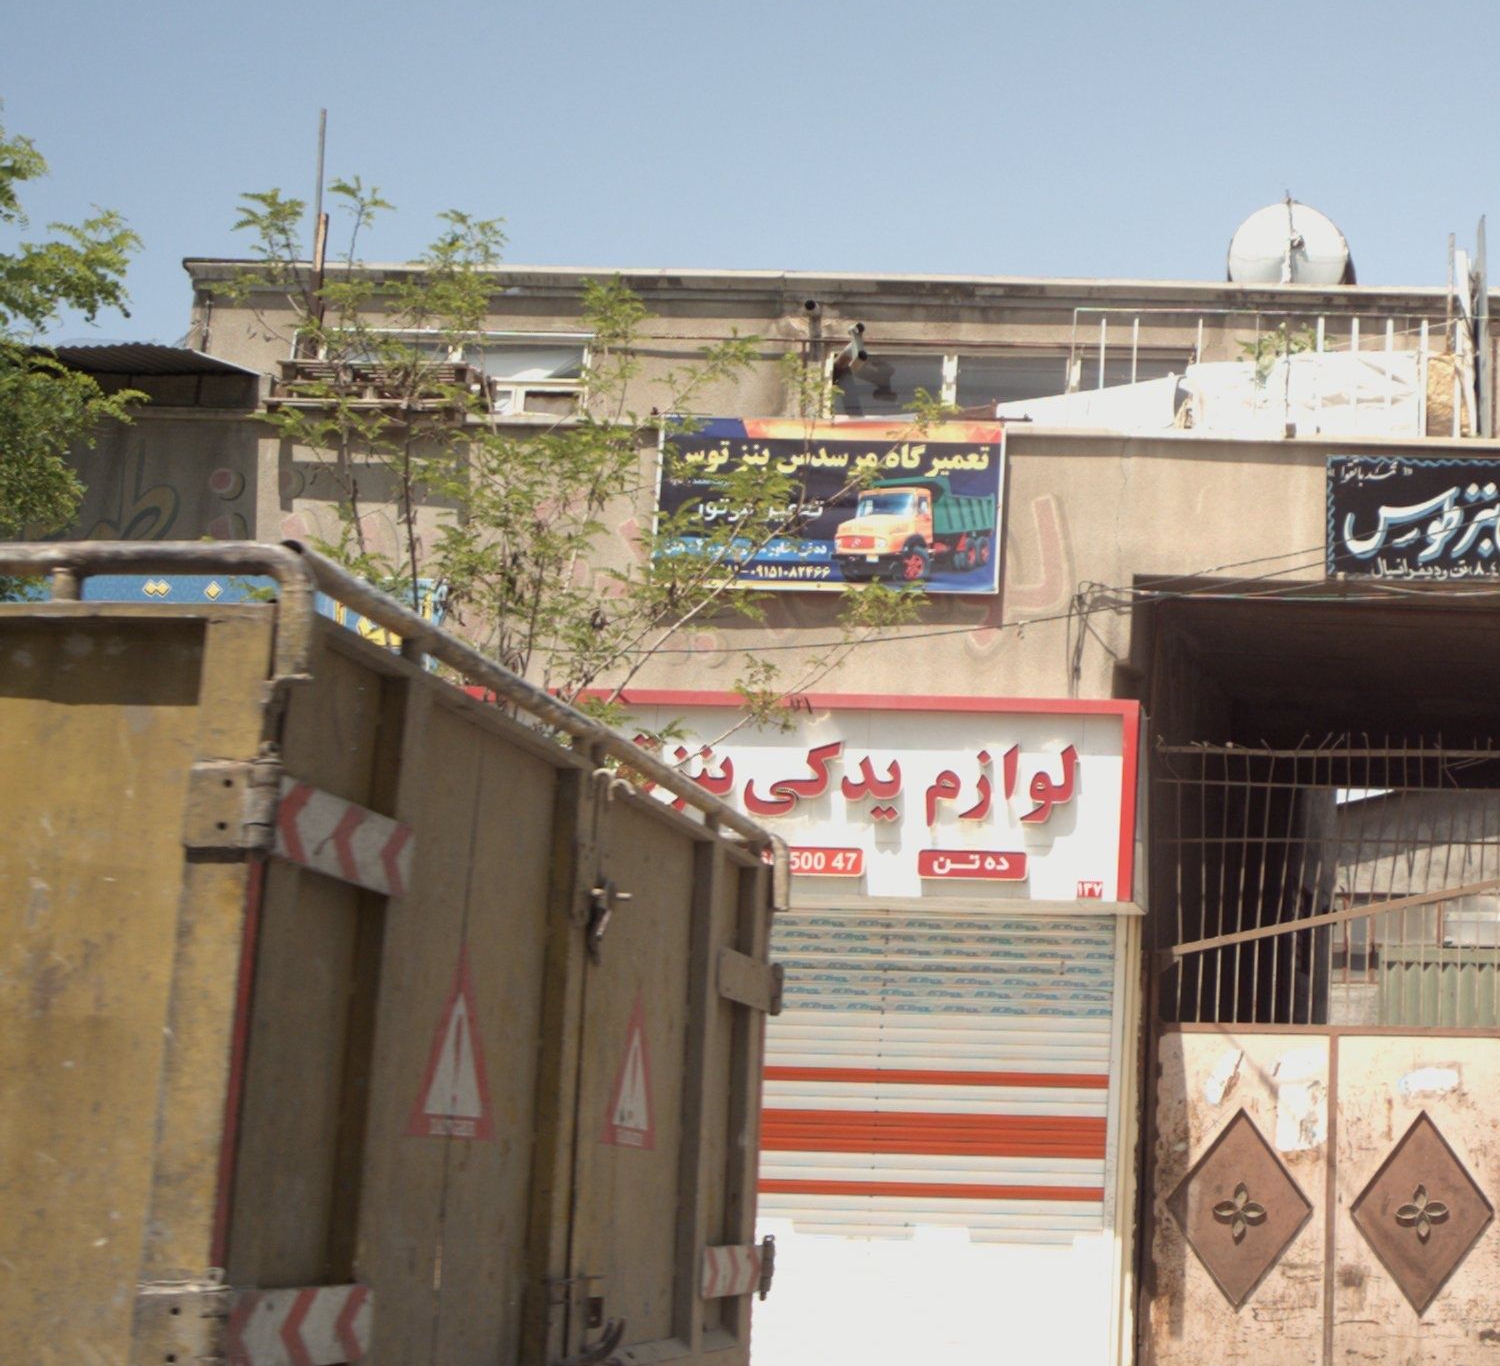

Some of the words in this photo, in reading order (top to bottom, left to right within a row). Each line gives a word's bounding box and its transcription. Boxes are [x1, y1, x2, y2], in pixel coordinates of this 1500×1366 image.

[739, 443, 771, 473] بنز
[743, 740, 902, 823] یدکی
[925, 742, 1081, 828] لوازم
[789, 850, 826, 871] 500
[831, 851, 859, 872] 47
[932, 853, 982, 875] تن
[984, 854, 1010, 872] ده
